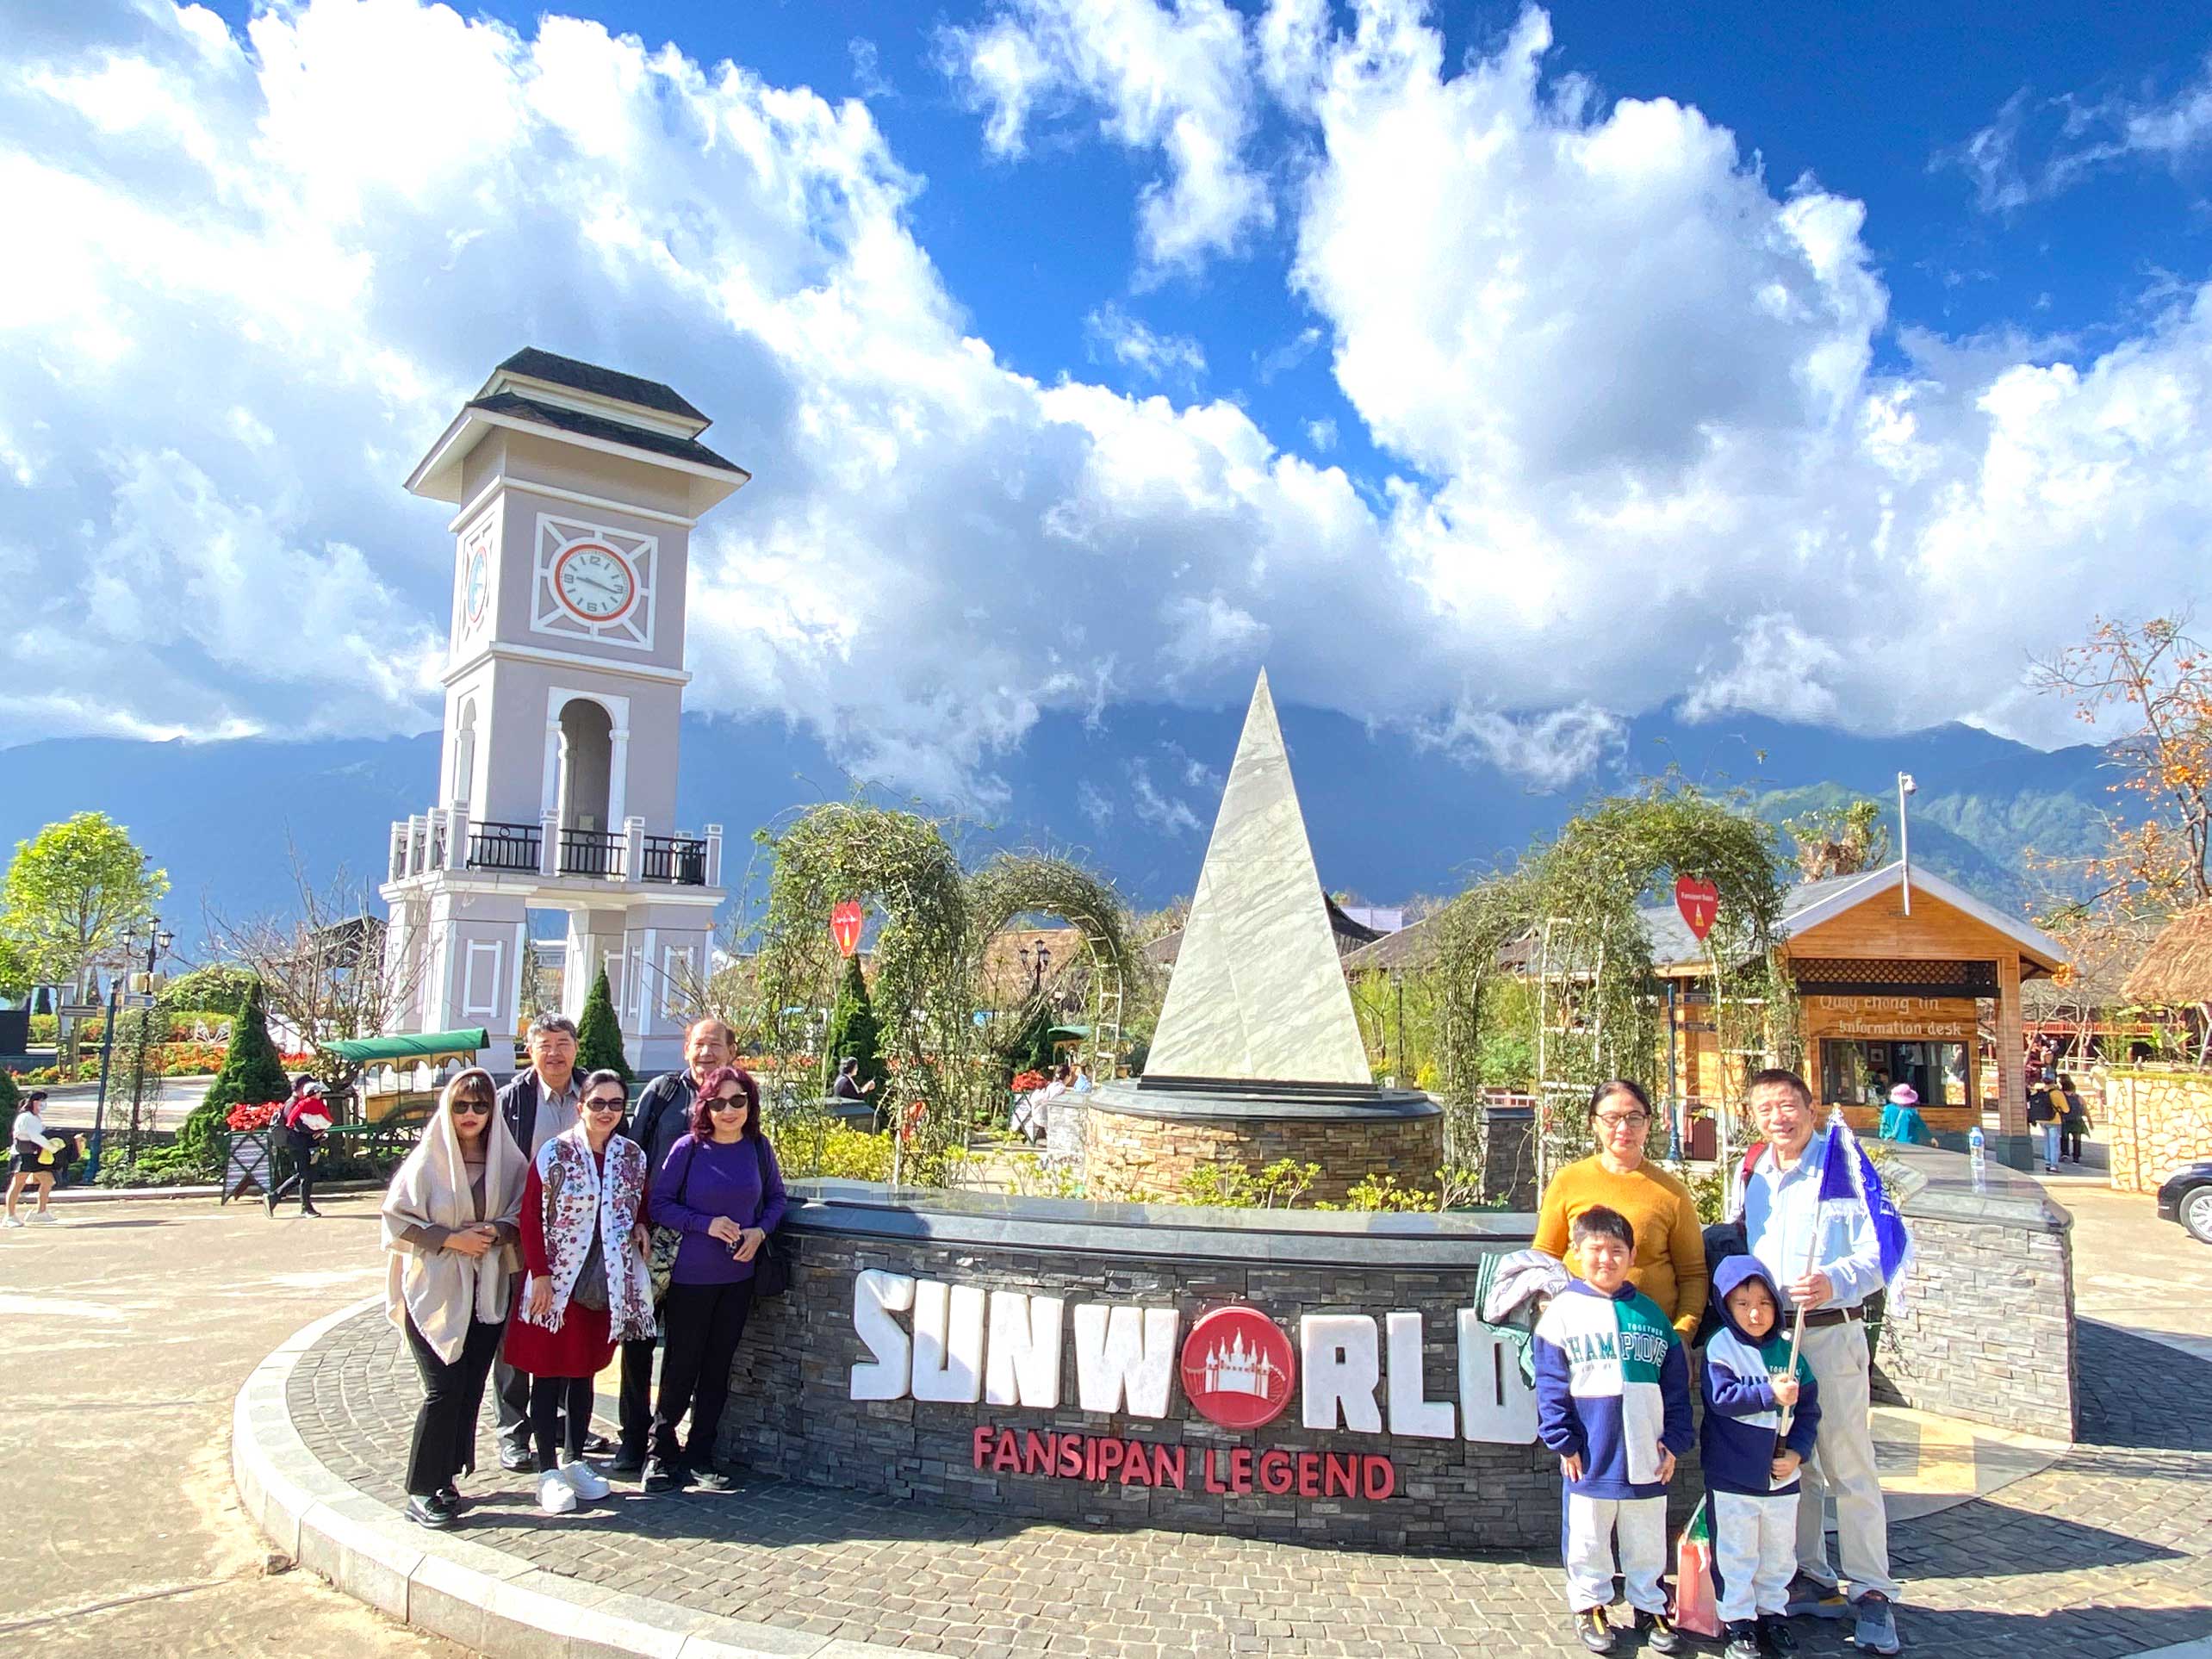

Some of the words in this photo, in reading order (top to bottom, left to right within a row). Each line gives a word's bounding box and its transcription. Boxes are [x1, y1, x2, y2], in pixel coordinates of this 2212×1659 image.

[590, 556, 600, 566] 12
[587, 602, 597, 612] 6
[1839, 1018, 1923, 1035] Information
[1928, 1022, 1962, 1036] desk
[1627, 1322, 1664, 1337] TOGETHER
[972, 1426, 1185, 1491] FANSIPAN
[1205, 1446, 1395, 1501] LEGEND
